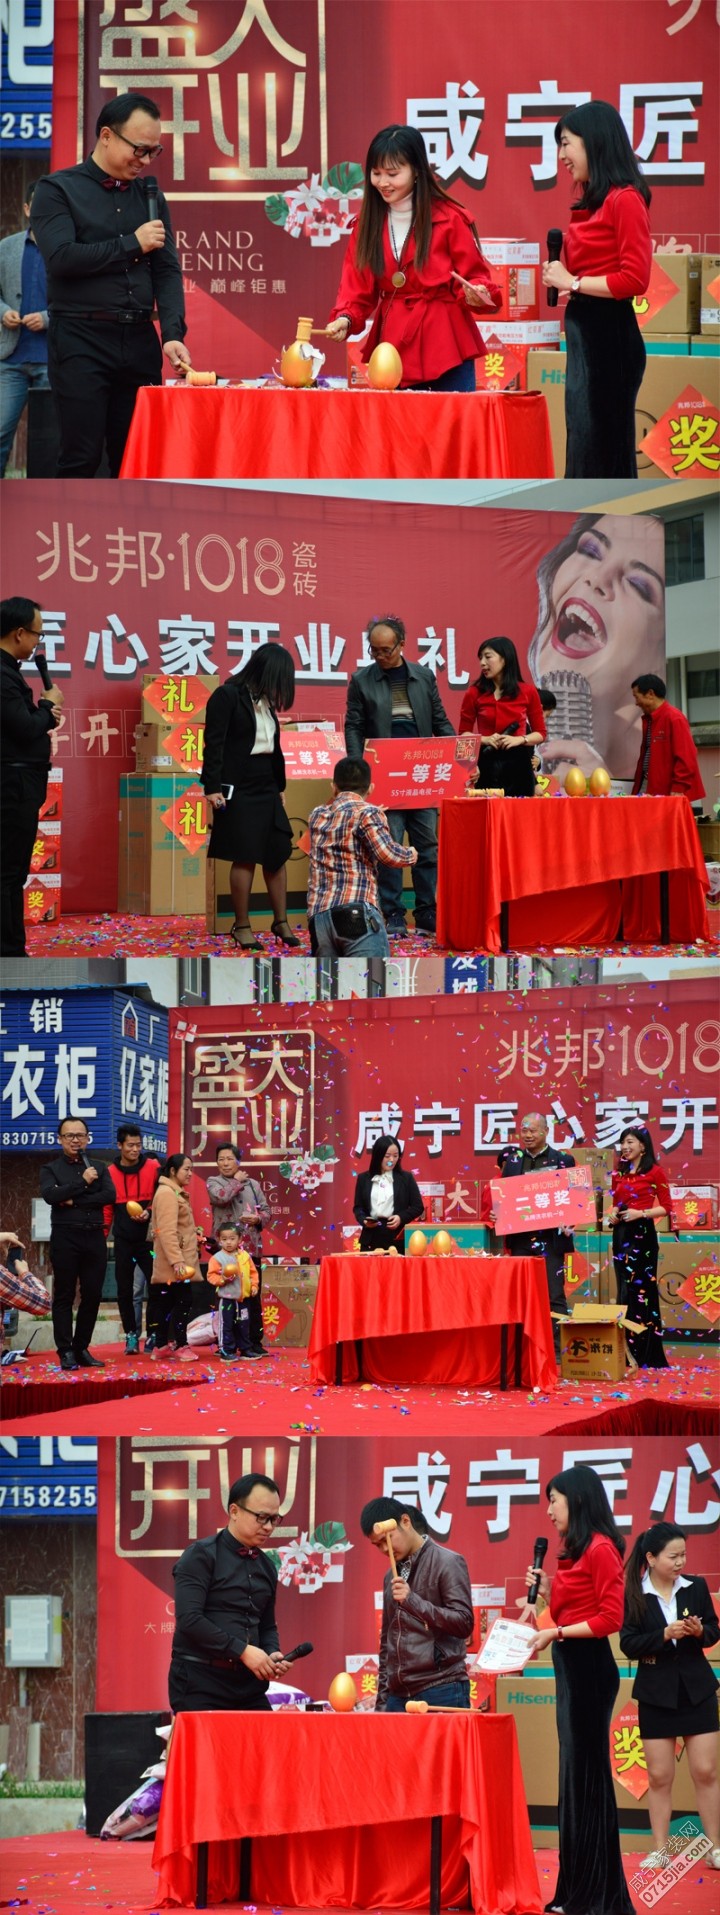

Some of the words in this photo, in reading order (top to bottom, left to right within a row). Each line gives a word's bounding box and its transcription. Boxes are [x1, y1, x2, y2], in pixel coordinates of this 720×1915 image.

[1, 112, 52, 139] 255
[175, 230, 253, 249] RAND
[181, 253, 264, 271] ENING
[210, 278, 286, 294] 巅峰钜惠
[485, 353, 505, 377] 奖
[670, 414, 720, 473] 奖
[291, 541, 318, 598] 瓷砖
[161, 678, 195, 712] 礼
[283, 750, 332, 766] 二等奖
[388, 762, 453, 783] 一等奖
[179, 801, 207, 835] 礼
[28, 891, 45, 908] 奖
[2, 1043, 97, 1120] 衣柜
[192, 1040, 304, 1099] 盛大
[191, 1098, 304, 1156] 开业
[444, 1181, 477, 1214] 大
[516, 1190, 571, 1211] 二等奖
[684, 1201, 698, 1215] 奖
[694, 1274, 720, 1306] 奖
[263, 1306, 280, 1325] 奖
[130, 1446, 300, 1540] 开业
[361, 1673, 378, 1694] 奖
[613, 1726, 648, 1774] 奖
